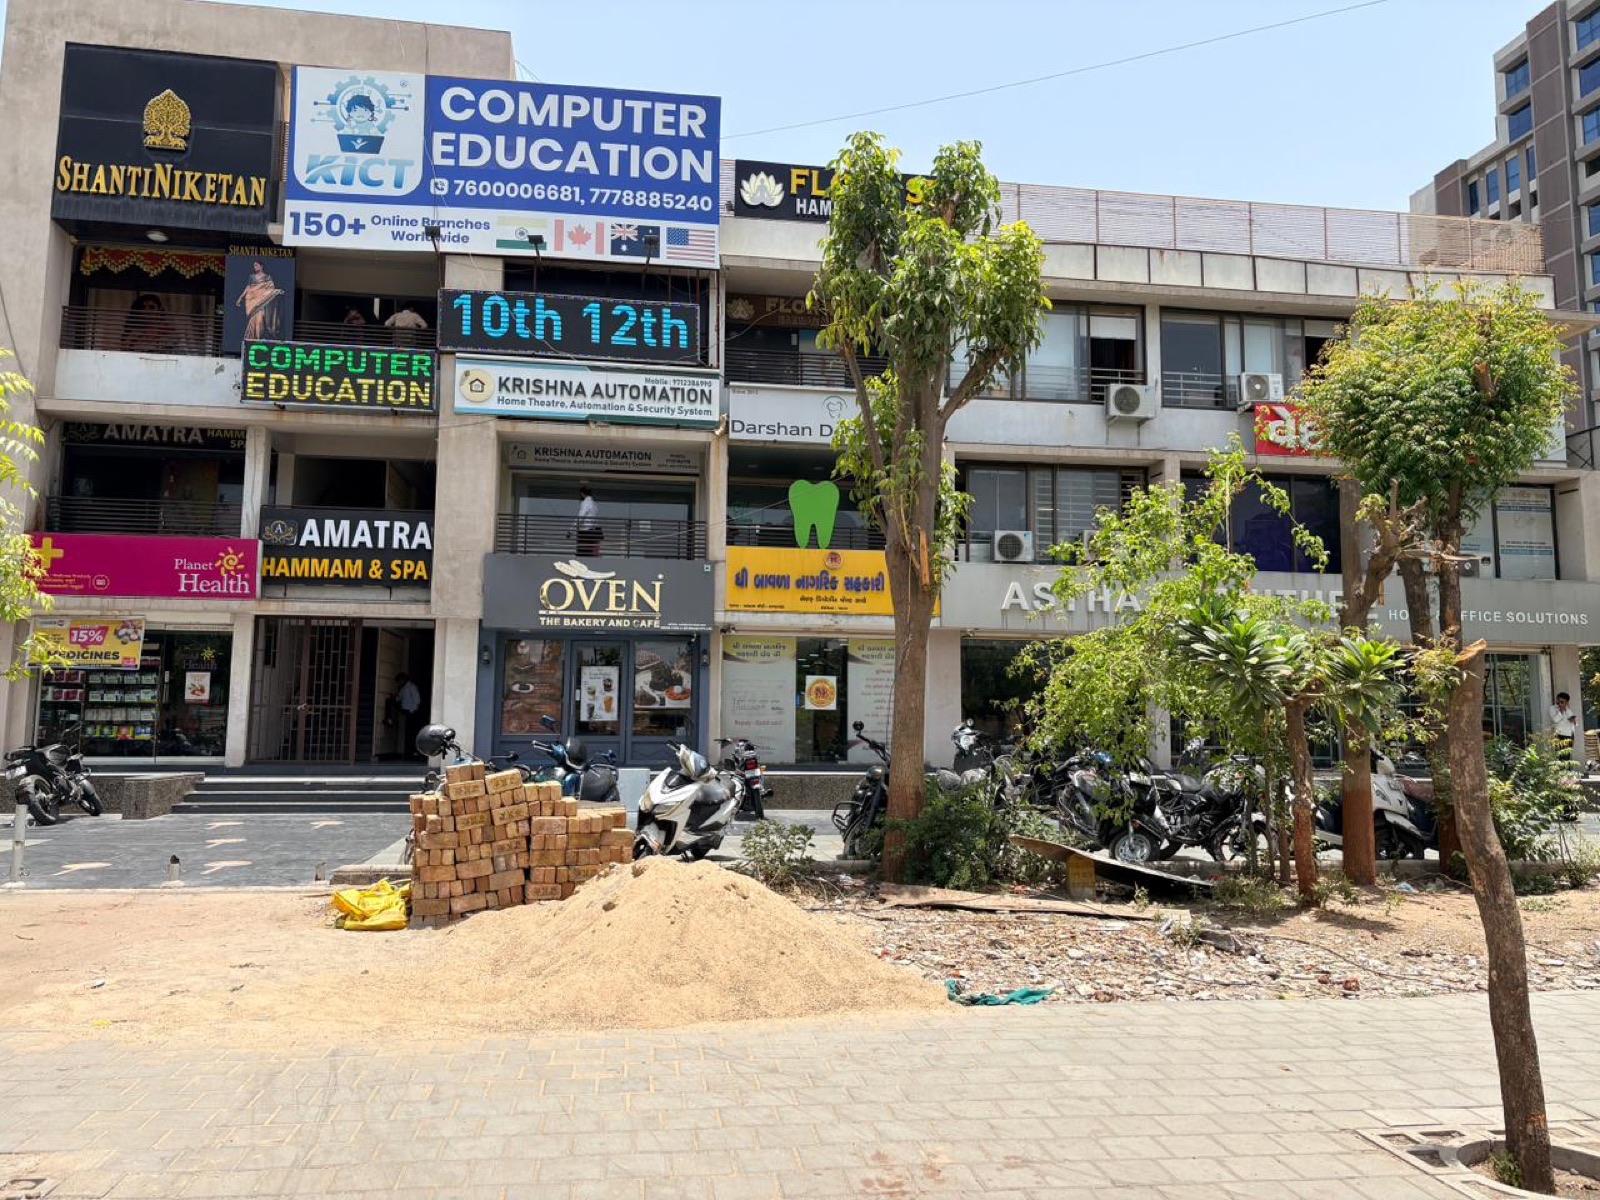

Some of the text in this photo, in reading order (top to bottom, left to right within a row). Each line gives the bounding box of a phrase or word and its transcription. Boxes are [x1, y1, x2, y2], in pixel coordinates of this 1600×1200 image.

[440, 86, 707, 139] COMPUTER
[431, 131, 713, 184] EDUCATION
[304, 153, 415, 190] KICT
[453, 179, 712, 212] 7600006681, 7778885240
[289, 211, 366, 237] 150+
[371, 214, 491, 231] Online Branches
[453, 293, 689, 349] 10th 12th
[248, 344, 432, 377] COMPUTER
[245, 371, 431, 406] EDUCATION
[498, 375, 712, 405] KRISHNA AUTOMATION
[497, 395, 527, 407] Home
[569, 399, 626, 413] Automation
[628, 403, 635, 412] &
[635, 403, 676, 417] Security
[677, 405, 713, 418] System
[103, 423, 204, 444] AMATRA
[731, 419, 812, 437] Darshan
[534, 446, 651, 462] KRISHNA AUTOMATION
[299, 518, 432, 550] AMATRA
[174, 558, 213, 571] Planet
[261, 556, 428, 581] HAMMAM & SPA
[178, 573, 251, 594] Health
[540, 616, 560, 626] THE
[563, 617, 606, 627] BAKERY
[608, 618, 631, 627] AND
[1460, 610, 1589, 625] FFICE SOLUTIONS
[70, 629, 104, 642] 15%
